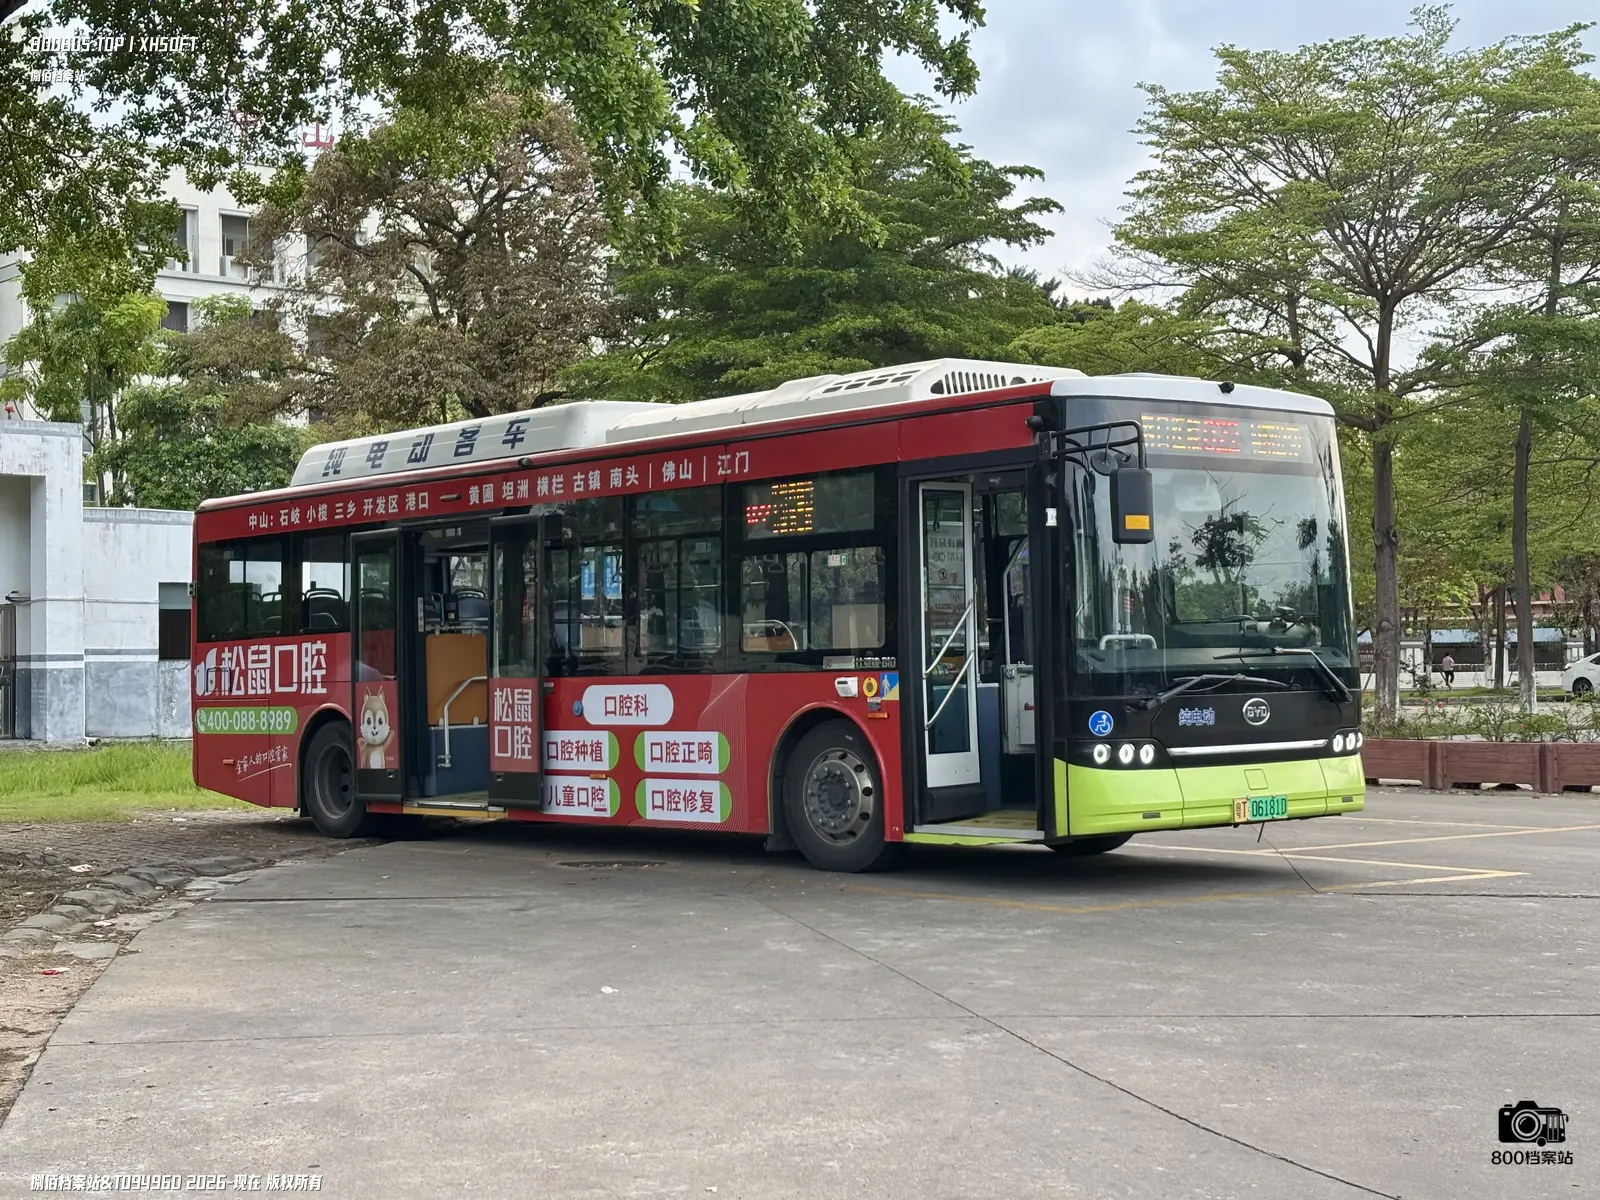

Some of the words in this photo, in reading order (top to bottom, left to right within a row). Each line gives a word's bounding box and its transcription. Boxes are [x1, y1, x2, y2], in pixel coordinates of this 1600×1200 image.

[321, 416, 531, 477] 纯电动客车
[279, 507, 301, 527] 石岐
[306, 503, 328, 523] 小榄
[334, 500, 357, 519] 三乡
[363, 494, 399, 516] 开发区
[405, 491, 429, 511] 港口
[468, 482, 495, 506] 黄圃
[502, 478, 529, 500] 坦洲
[536, 475, 564, 497] 横栏
[572, 469, 601, 493] 古镇
[609, 464, 639, 489] 南头
[661, 458, 692, 482] 佛山
[716, 450, 749, 475] 江门
[221, 640, 327, 697] 松鼠口腔
[494, 687, 533, 723] 松鼠
[603, 693, 650, 718] 口腔科
[1178, 706, 1216, 726] 纯电动
[1246, 705, 1267, 718] BYD
[206, 710, 292, 731] 400-088-8989
[494, 725, 533, 760] 口腔
[546, 739, 604, 763] 口腔种植
[649, 740, 713, 765] 口腔正畸
[548, 785, 605, 808] 儿童口腔
[651, 789, 715, 814] 口腔修复
